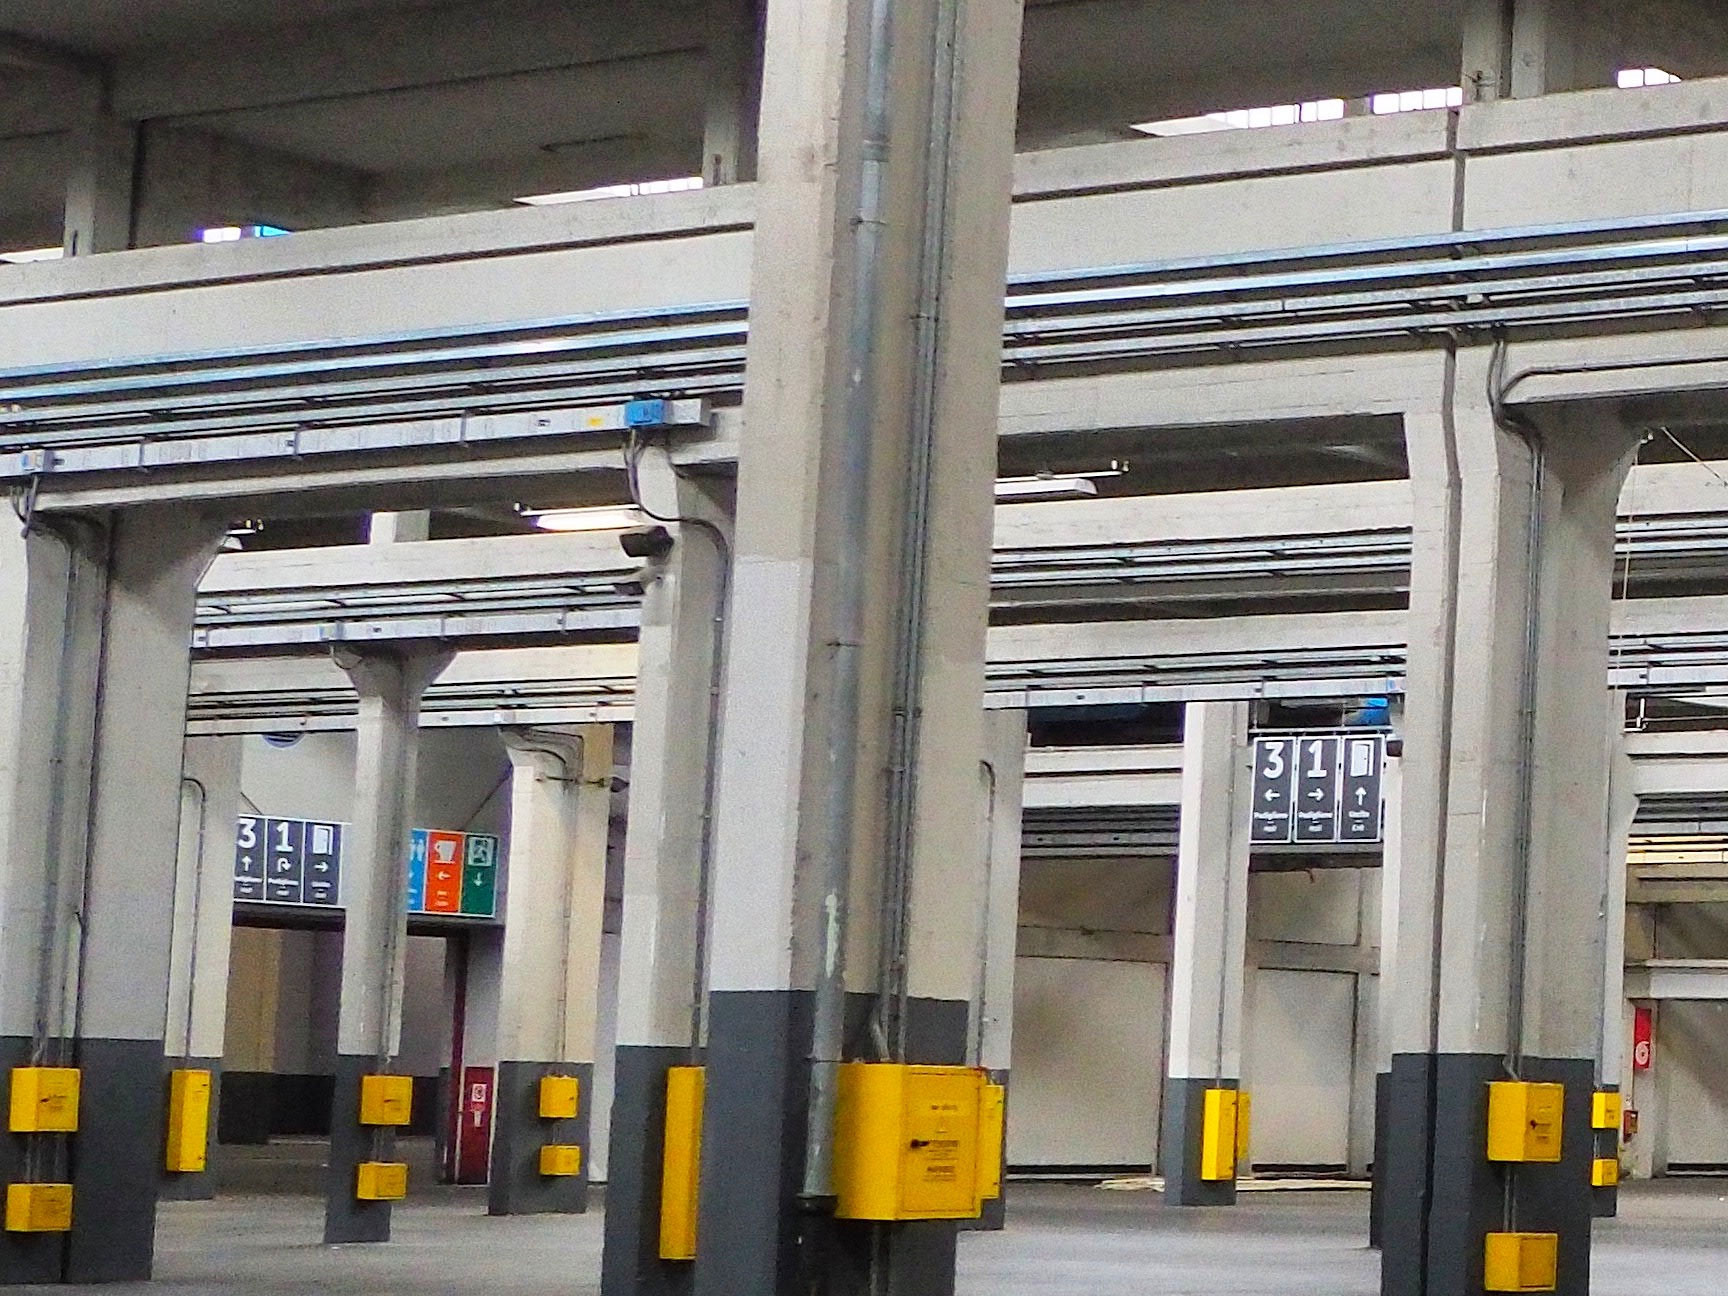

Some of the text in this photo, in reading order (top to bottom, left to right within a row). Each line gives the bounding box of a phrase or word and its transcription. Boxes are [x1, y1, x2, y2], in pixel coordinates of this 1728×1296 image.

[1263, 741, 1284, 779] 3
[1307, 740, 1328, 778] 1
[238, 818, 256, 849] 3
[275, 821, 294, 852] 1
